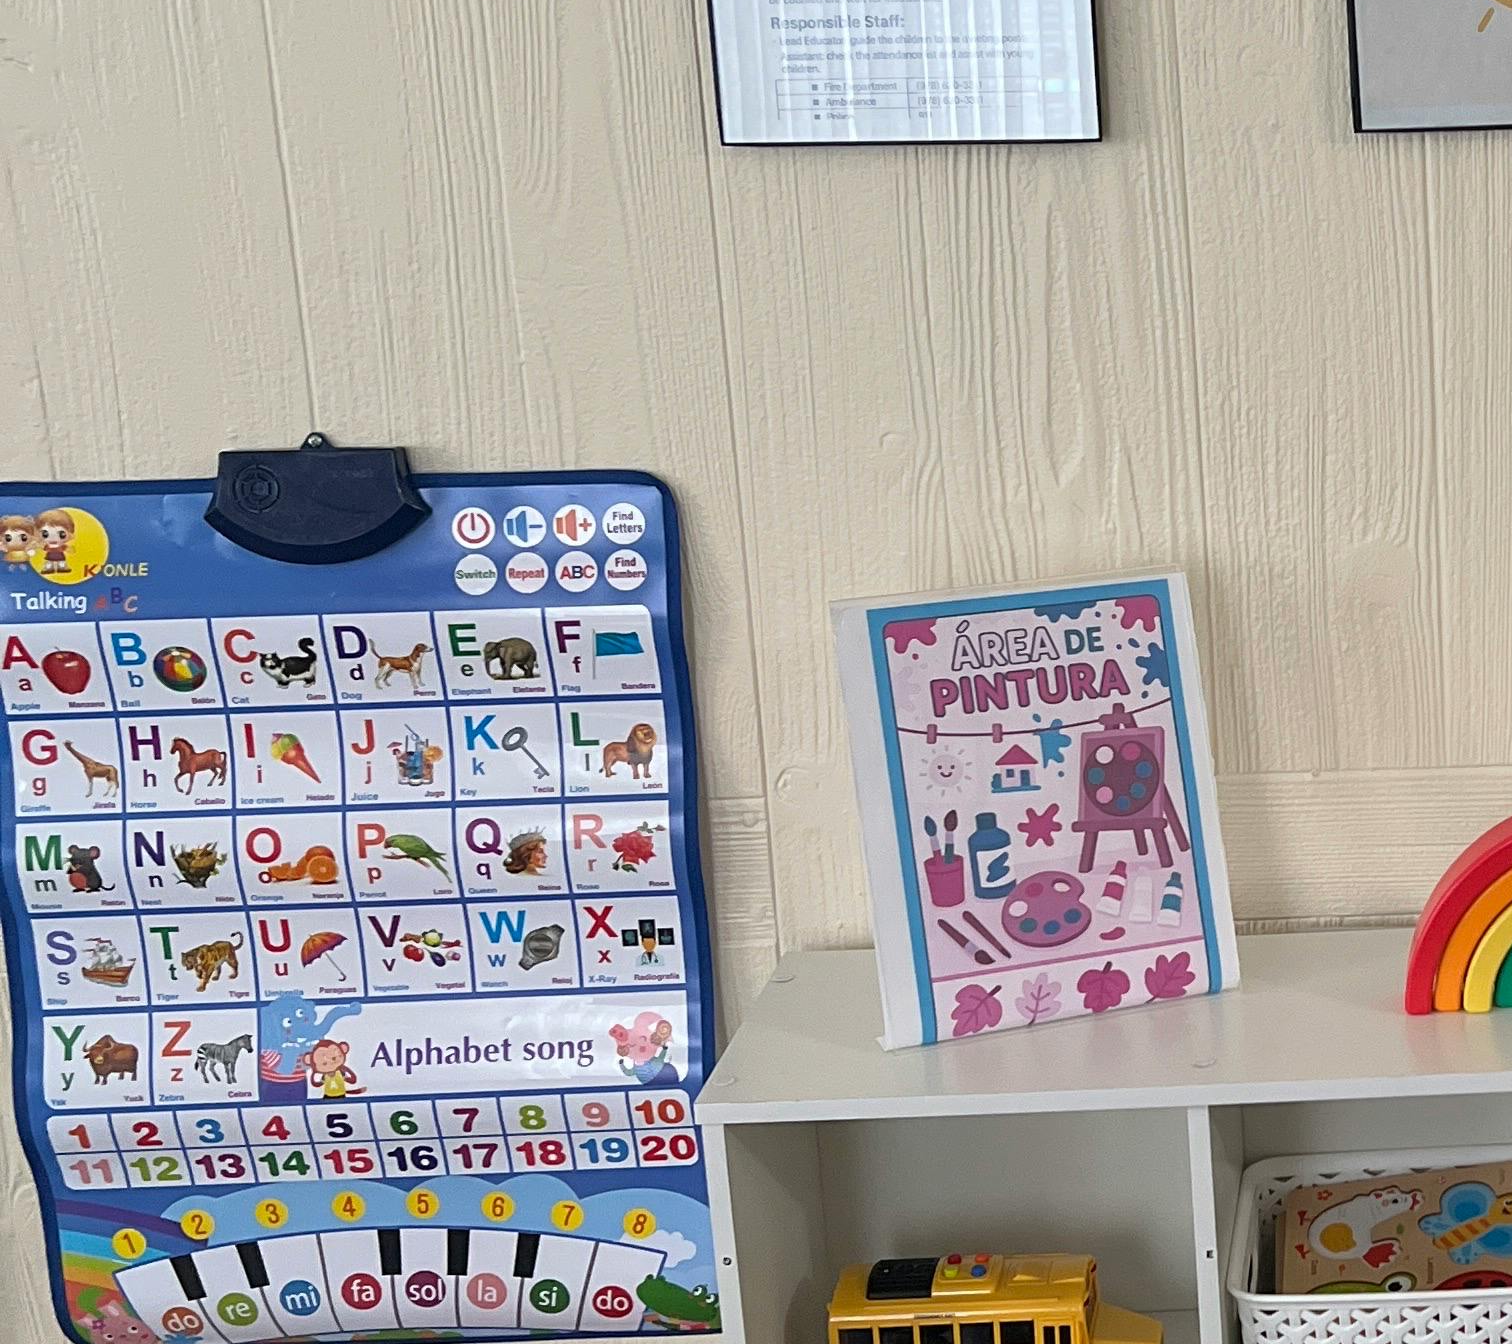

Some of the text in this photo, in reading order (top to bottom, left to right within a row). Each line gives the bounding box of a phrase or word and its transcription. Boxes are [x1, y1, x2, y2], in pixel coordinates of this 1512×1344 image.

[865, 13, 906, 29] Staff:
[606, 522, 643, 534] Letters
[612, 511, 634, 521] Find
[455, 565, 595, 581] Switch Repeat ABC
[607, 568, 646, 579] Numbers
[614, 557, 637, 567] Find
[10, 592, 87, 614] Talking
[2, 635, 40, 670] A
[110, 632, 147, 667] B
[223, 628, 258, 664] C
[332, 625, 368, 660] D
[447, 623, 482, 657] E
[554, 620, 582, 654] F
[951, 619, 1104, 671] ÁREA DE
[127, 670, 144, 688] b
[350, 663, 365, 681] d
[460, 663, 474, 677] e
[571, 656, 582, 673] f
[18, 678, 33, 691] a
[341, 691, 362, 701] Dog
[930, 658, 1130, 718] PINTURA
[128, 725, 162, 761] H
[351, 719, 376, 755] J
[464, 714, 499, 751] K
[570, 712, 600, 747] L
[21, 729, 58, 766] G
[143, 769, 157, 788] h
[472, 757, 485, 775] k
[32, 777, 47, 796] g
[351, 792, 379, 801] Juice
[459, 788, 477, 797] Key
[569, 785, 589, 793] Lion
[245, 827, 282, 864] O
[357, 823, 386, 859] P
[465, 817, 504, 856] Q
[572, 813, 608, 850] R
[24, 835, 63, 872] M
[134, 831, 166, 868] N
[587, 858, 597, 872] r
[34, 878, 58, 892] m
[149, 874, 164, 888] n
[367, 867, 382, 884] p
[476, 863, 492, 880] q
[258, 919, 291, 953] U
[368, 914, 401, 948] V
[479, 910, 526, 944] W
[582, 906, 618, 940] X
[46, 930, 77, 966] S
[150, 926, 180, 960] T
[168, 964, 178, 981] t
[588, 975, 617, 984] X-Ray
[51, 1024, 86, 1061] Y
[161, 1021, 192, 1057] Z
[370, 1036, 594, 1075] Alphabet song
[61, 1072, 75, 1092] y
[68, 1098, 686, 1150] 1 2 3 4 5 6 7 8 9 10
[69, 1134, 696, 1185] 11 12 13 14 15 16 17 18 19 20
[121, 1193, 647, 1254] 1 2 3 4 5 6 7 8
[166, 1278, 628, 1333] do re mi fa sol la si do
